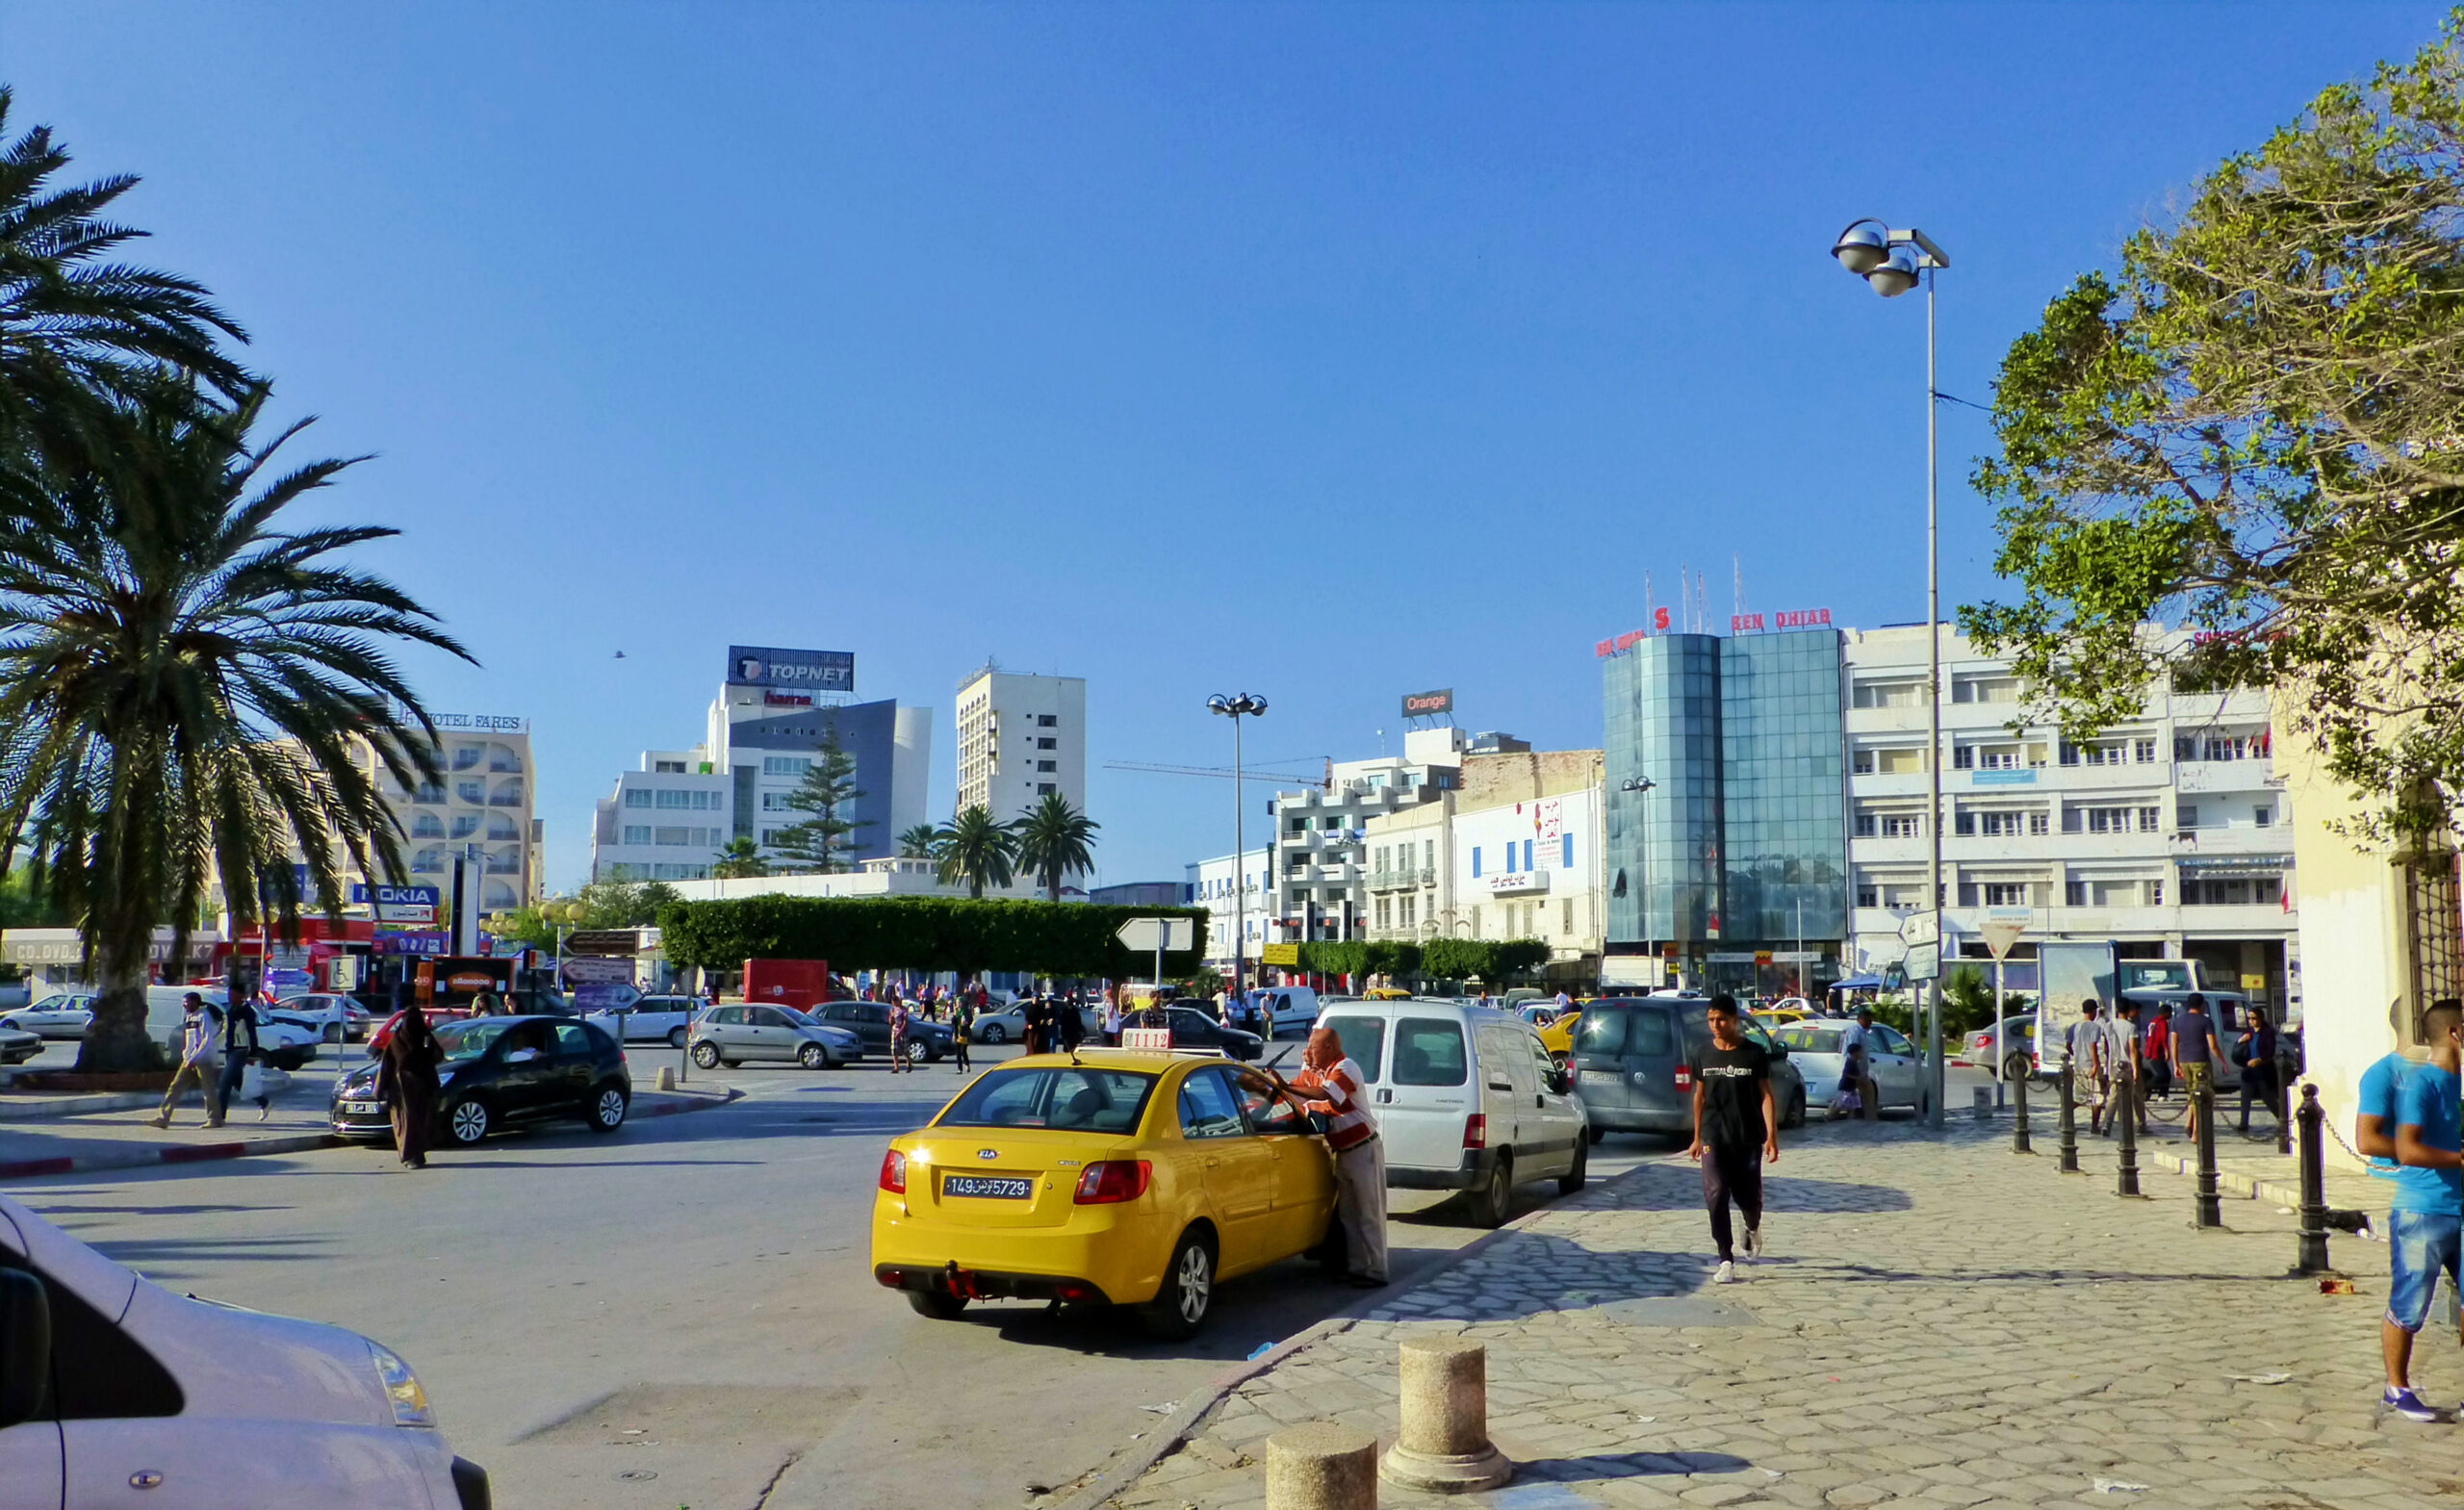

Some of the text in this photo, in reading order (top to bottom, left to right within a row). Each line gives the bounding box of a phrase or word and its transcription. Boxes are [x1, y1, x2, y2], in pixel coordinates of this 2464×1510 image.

[1732, 608, 1831, 631] BEN DHIAB
[769, 664, 850, 681] TOPNET
[1407, 696, 1446, 710] Orange
[475, 715, 520, 729] FARES
[1135, 1033, 1168, 1048] 1112
[978, 1150, 996, 1159] KIA
[951, 1178, 973, 1193] 149
[992, 1180, 1026, 1196] 5729
